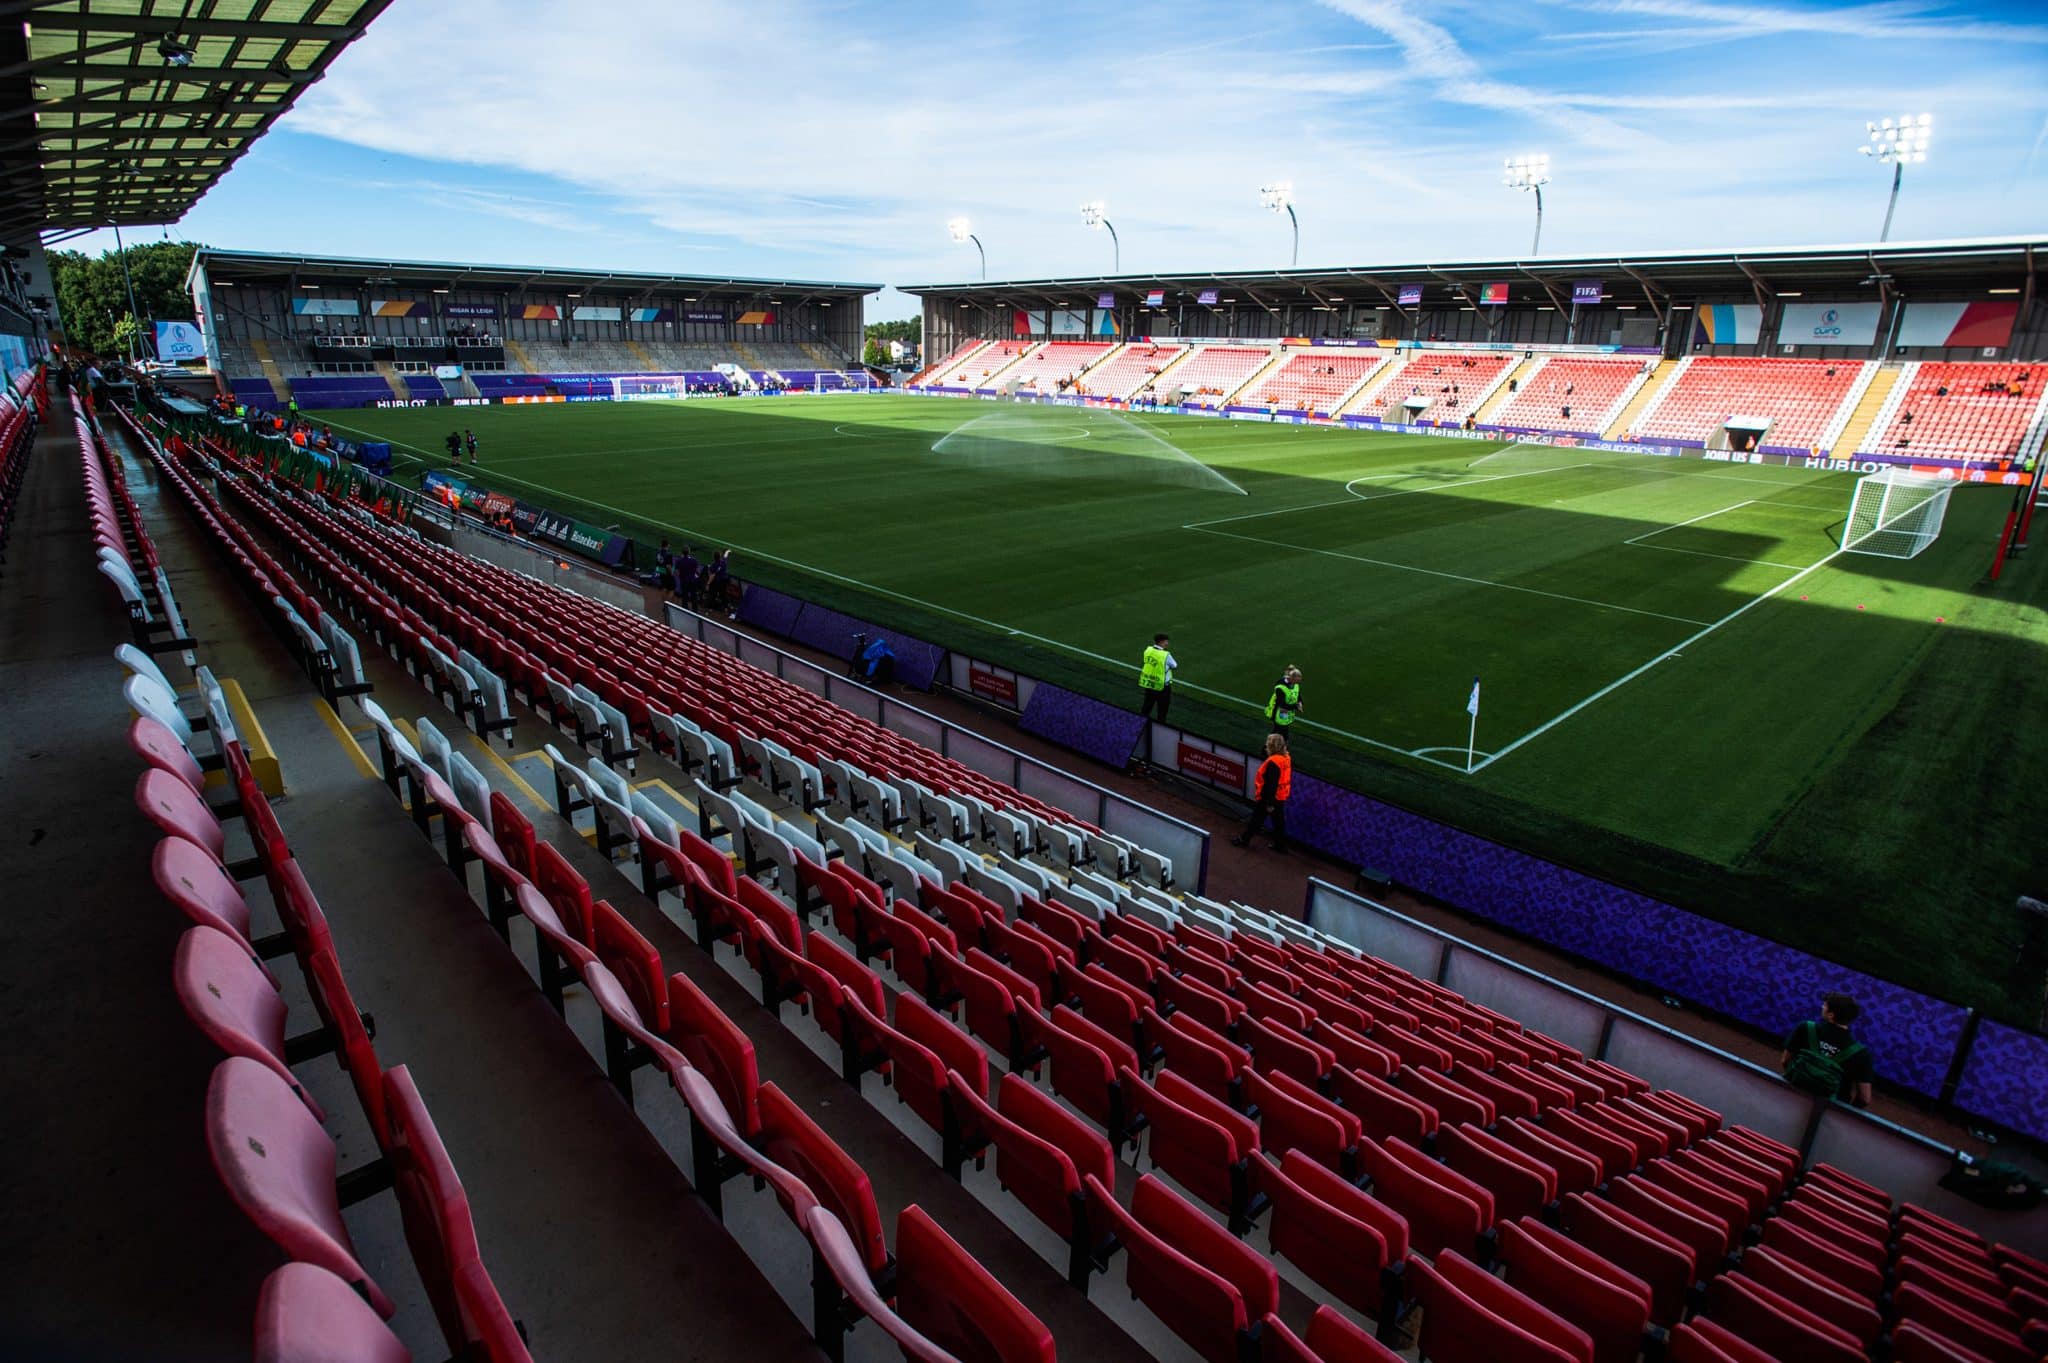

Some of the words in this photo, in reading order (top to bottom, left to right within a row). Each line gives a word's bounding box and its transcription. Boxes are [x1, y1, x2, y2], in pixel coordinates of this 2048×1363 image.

[1575, 287, 1598, 296] FIFA
[377, 399, 428, 409] HUBLOT
[1427, 426, 1484, 440] Heineken
[1703, 449, 1729, 461] JOIN
[1731, 451, 1748, 463] US
[1804, 457, 1892, 474] HUBLOT
[570, 530, 598, 549] Heineken
[131, 607, 143, 619] M
